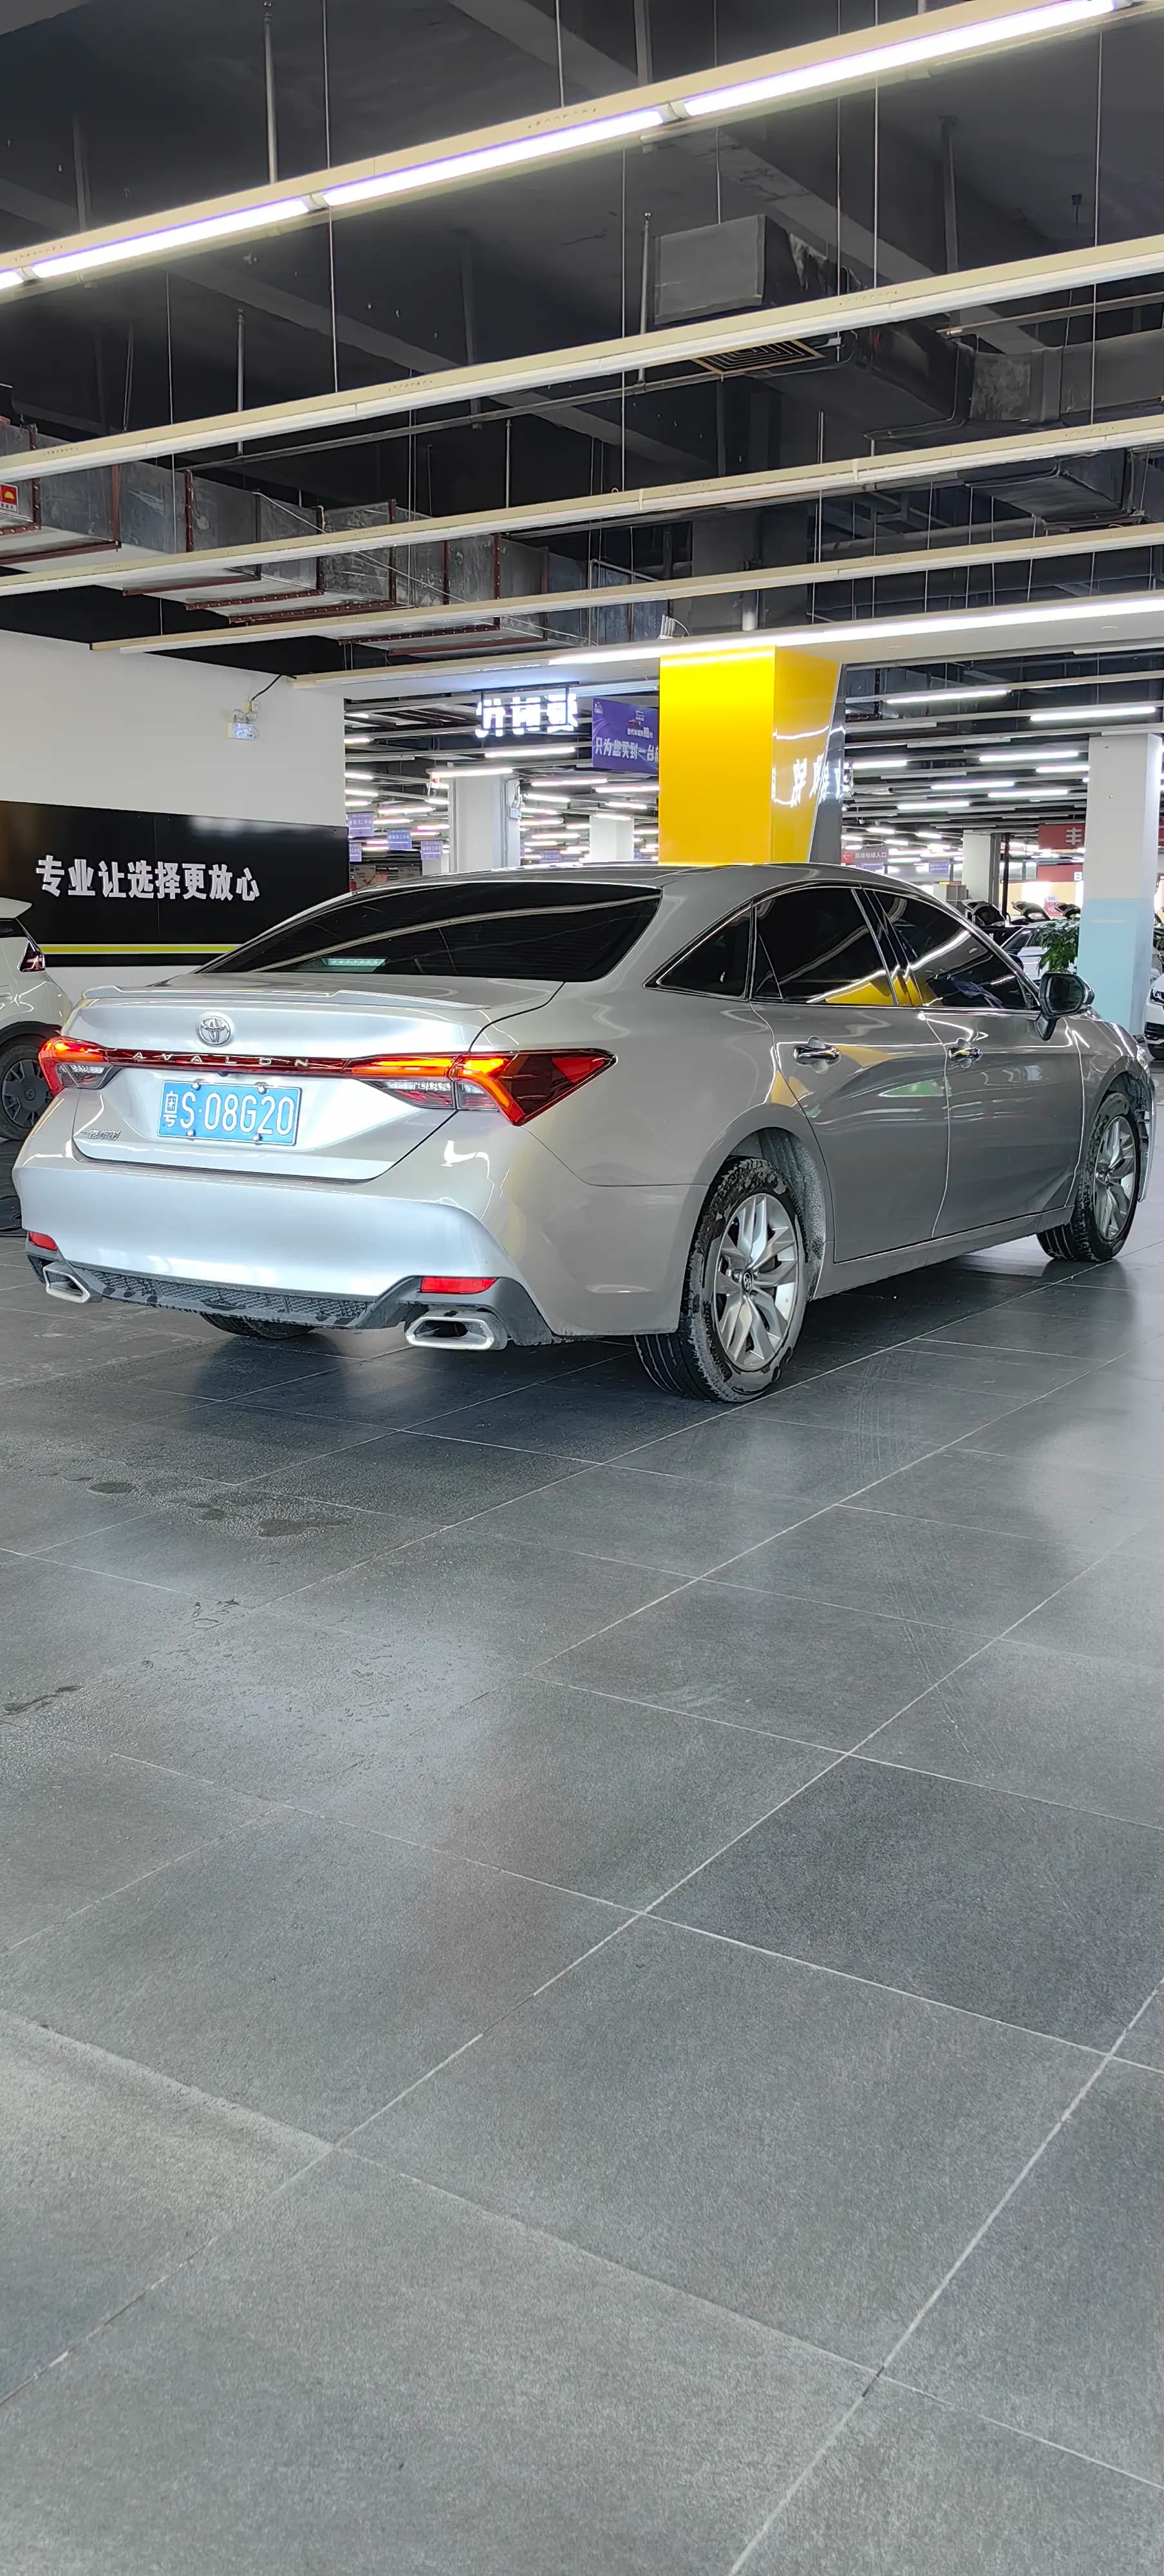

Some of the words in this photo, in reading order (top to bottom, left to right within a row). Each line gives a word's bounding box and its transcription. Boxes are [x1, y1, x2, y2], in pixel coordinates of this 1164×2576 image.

[36, 855, 260, 901] 专业让选择更放心
[133, 1051, 310, 1066] AVALON
